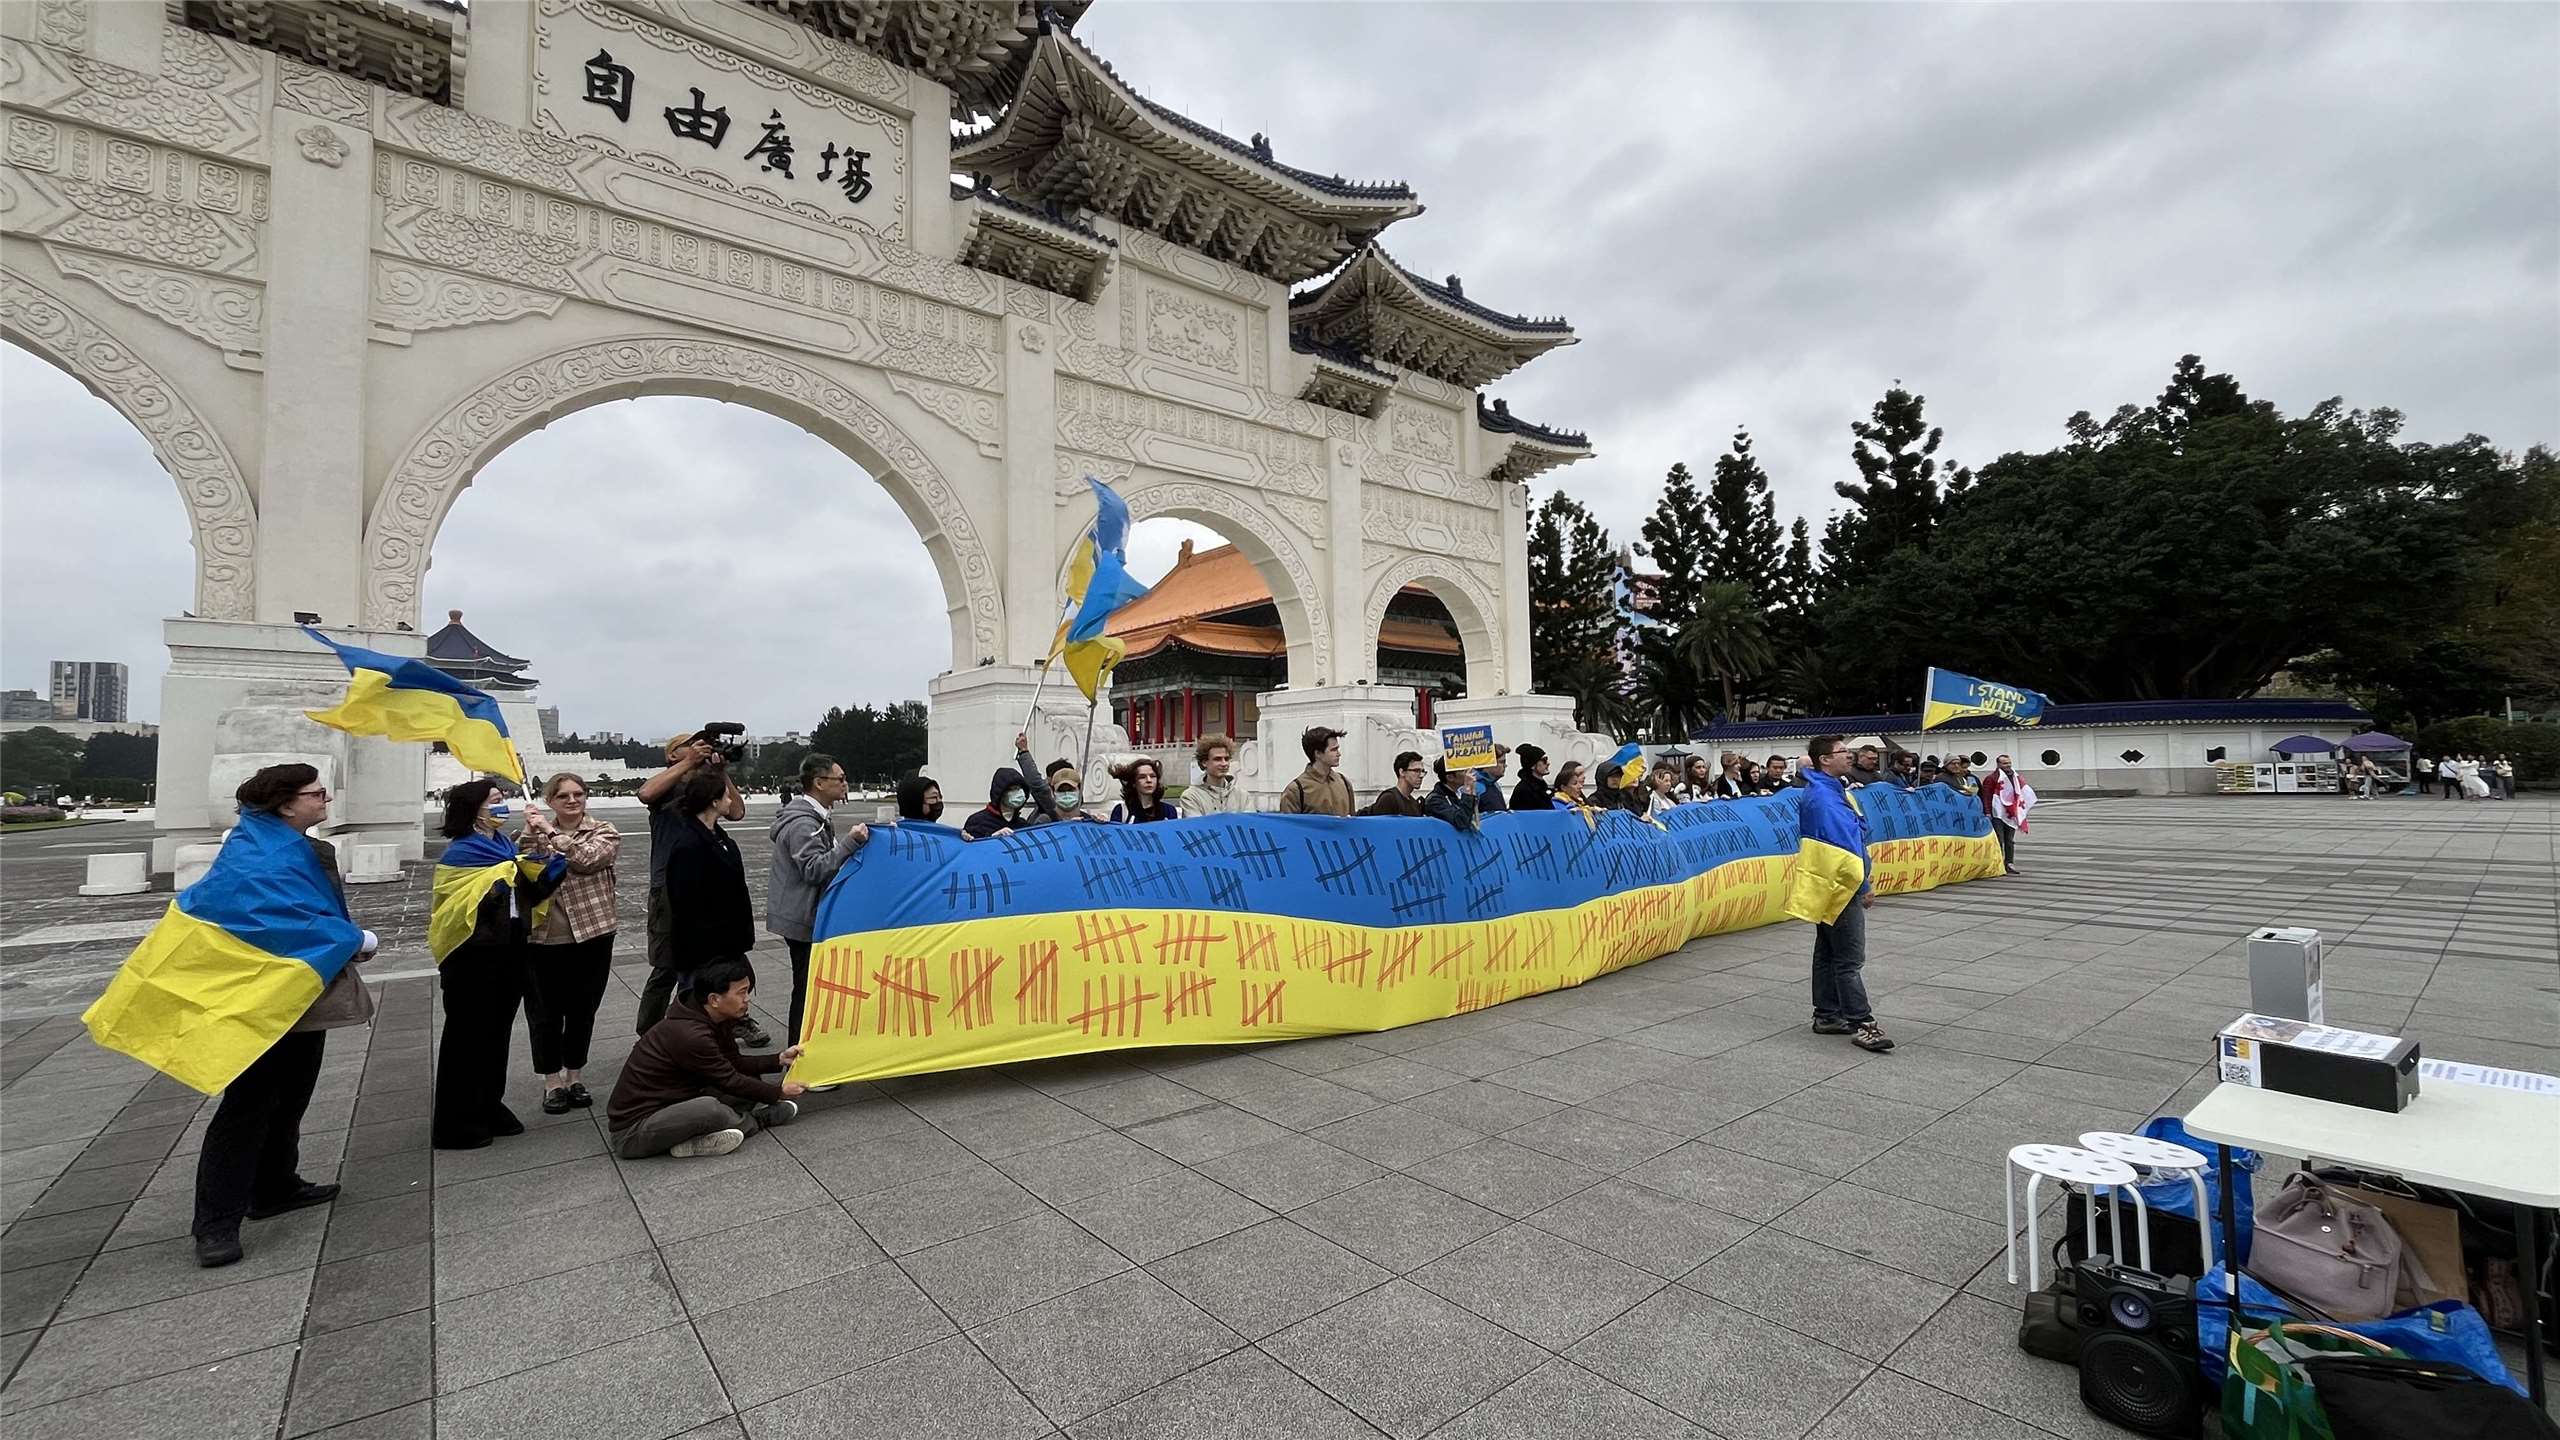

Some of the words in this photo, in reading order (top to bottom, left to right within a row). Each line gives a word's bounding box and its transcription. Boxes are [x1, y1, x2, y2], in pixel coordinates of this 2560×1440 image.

[1978, 684, 2026, 704] STAND
[1981, 698, 2016, 714] WITH
[1445, 730, 1484, 745] TAIWAN
[1446, 745, 1492, 759] UKRAINE
